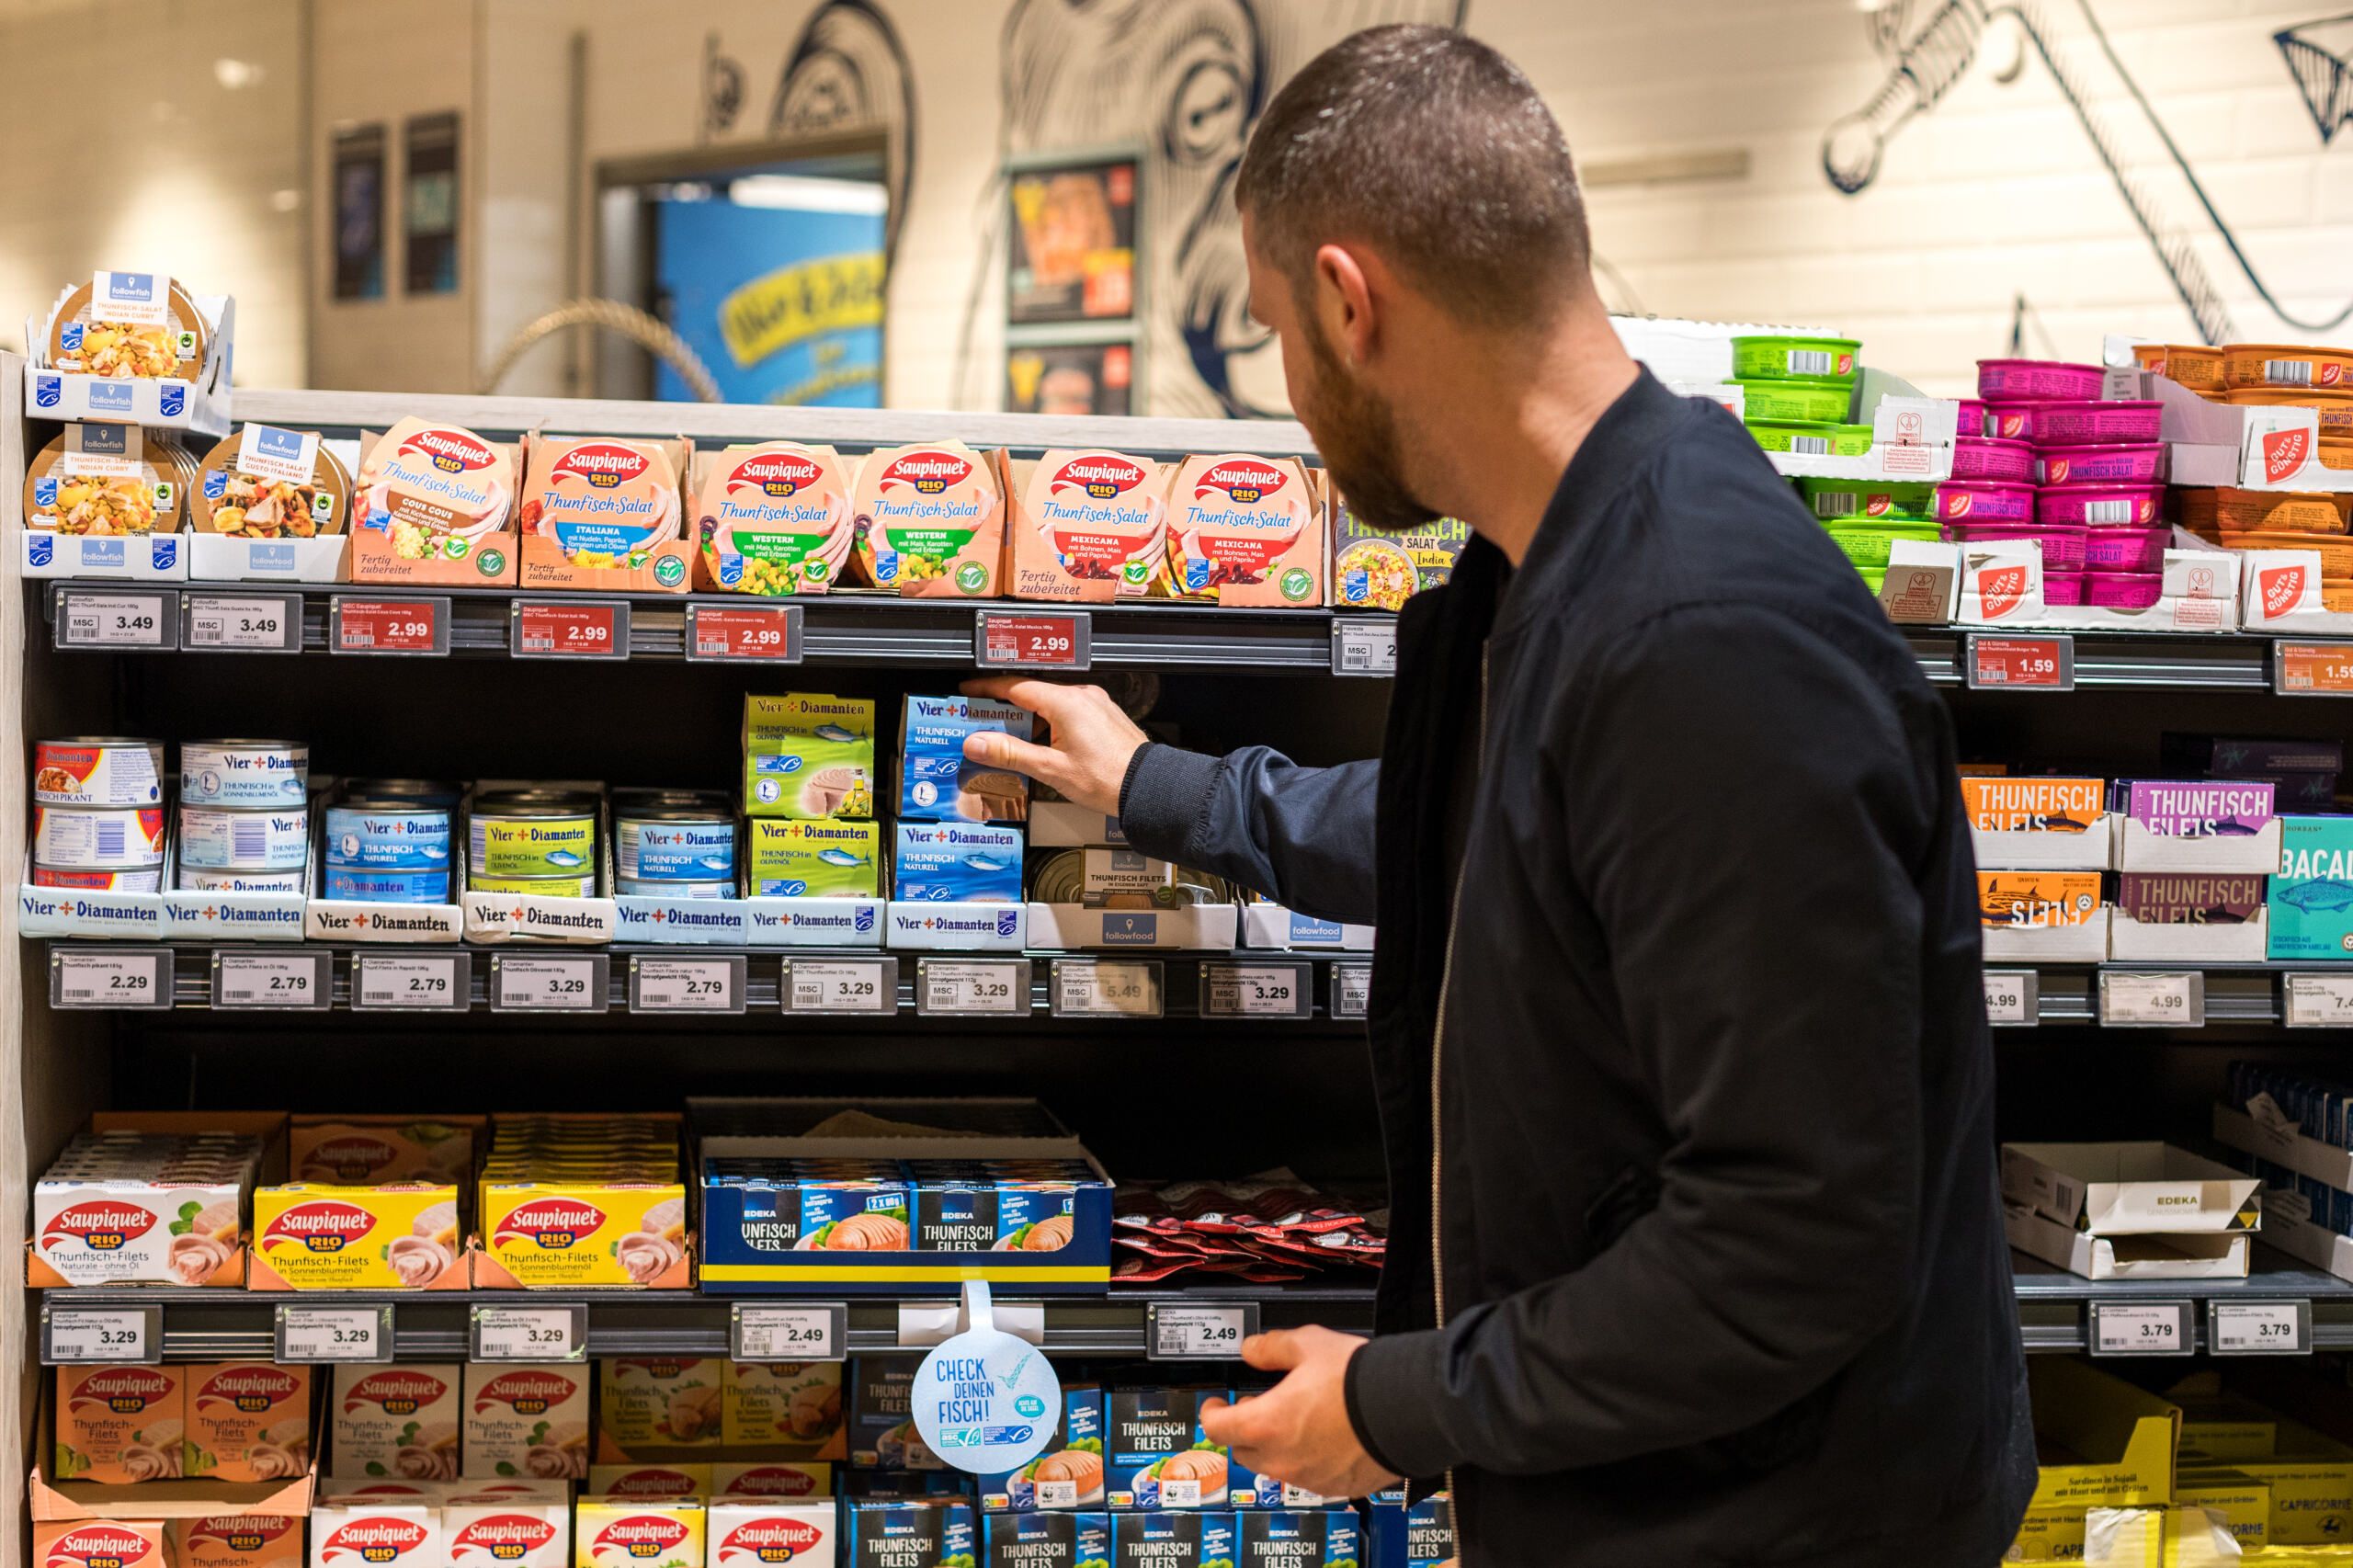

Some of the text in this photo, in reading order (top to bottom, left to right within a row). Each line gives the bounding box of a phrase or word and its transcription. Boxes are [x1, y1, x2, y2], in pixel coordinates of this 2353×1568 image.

[111, 286, 152, 298] followfish
[84, 438, 124, 449] followfish
[417, 431, 491, 465] Saupiquet
[2270, 433, 2302, 475] GÜNSTIG
[244, 454, 308, 473] THUNFISCH SALAT
[567, 452, 642, 472] Saupiquet
[894, 458, 965, 478] Saupiquet
[742, 460, 815, 482] Saupiquet
[1066, 461, 1139, 485] Saupiquet
[2070, 465, 2133, 477] THUNFISCH SALAT
[1209, 467, 1280, 489] Saupiquet
[765, 483, 793, 493] RIO
[1231, 489, 1260, 500] RIO
[402, 497, 454, 519] COUS COUS
[720, 501, 827, 523] Thunfisch-Salat
[1042, 501, 1149, 525] Thunfisch-Salat
[575, 526, 620, 536] ITALIANA
[752, 535, 795, 544] WESTERN
[1071, 535, 1120, 546] MEXICANA
[1407, 538, 1435, 550] SALAT
[744, 543, 755, 551] mit
[756, 544, 771, 553] Mais,
[82, 552, 124, 564] followfish
[251, 555, 293, 566] followfood
[1417, 552, 1445, 565] India
[360, 565, 412, 576] zubereitet
[1019, 569, 1058, 584] Fertig
[1019, 581, 1081, 596] zubereitet
[2267, 571, 2299, 611] GÜNSTIG
[74, 619, 94, 627] MSC
[116, 616, 153, 630] 3.49
[198, 621, 218, 630] MSC
[240, 619, 277, 632] 3.49
[388, 622, 427, 637] 2.99
[742, 631, 780, 644] 2.99
[1031, 635, 1069, 651] 2.99
[2019, 659, 2054, 673] 1.59
[757, 699, 865, 715] Vier Diamanten
[916, 701, 1024, 722] Vier Diamanten
[915, 726, 965, 737] THUNFISCH
[915, 737, 949, 745] NATURELL
[46, 752, 93, 763] Diamanten
[223, 782, 266, 790] THUNFISCH
[59, 794, 93, 803] PIKANT
[1979, 784, 2098, 812] THUNFISCH
[2150, 790, 2268, 817] THUNFISCH
[761, 824, 869, 841] Vier Diamanten
[906, 828, 1014, 846] Vier Diamanten
[364, 845, 413, 854] THUNFISCH
[364, 855, 397, 863] NATURELL
[760, 858, 790, 866] OLIVENÖL
[904, 853, 955, 863] THUNFISCH
[904, 863, 938, 871] NATURELL
[1090, 874, 1137, 882] THUNFISCH
[2140, 879, 2257, 905] THUNFISCH
[23, 897, 157, 921] Vier Diamanten
[166, 905, 301, 923] Vier Diamanten
[619, 905, 742, 926] Vier Diamanten
[475, 905, 604, 929] Vier Diamanten
[897, 915, 995, 932] Vier Diamanten
[1105, 930, 1154, 941] followfood
[1292, 927, 1340, 936] followfood
[110, 976, 148, 989] 2.29
[270, 977, 307, 990] 2.79
[549, 980, 585, 993] 3.29
[687, 981, 722, 994] 2.79
[973, 984, 1008, 996] 3.29
[1067, 988, 1087, 996] MSC
[1107, 985, 1142, 998] 5.49
[1256, 987, 1289, 999] 3.29
[1985, 994, 2018, 1007] 4.99
[2150, 995, 2183, 1008] 4.99
[2157, 1197, 2198, 1206] EDEKA
[60, 1209, 148, 1231] Saupiquet
[511, 1208, 597, 1230] Saupiquet
[744, 1210, 777, 1218] EDEKA
[279, 1210, 368, 1233] Saupiquet
[87, 1234, 122, 1244] RIO
[539, 1233, 572, 1244] RIO
[923, 1224, 994, 1241] THUNFISCH
[51, 1251, 150, 1262] Thunfisch-Filets
[503, 1253, 598, 1263] Thunfisch-Filets
[61, 1262, 97, 1270] Naturale
[128, 1262, 140, 1270] Öl
[528, 1329, 563, 1342] 3.29
[788, 1328, 824, 1342] 2.49
[2141, 1324, 2172, 1336] 3.79
[2259, 1324, 2290, 1335] 3.79
[100, 1331, 137, 1344] 3.29
[937, 1358, 986, 1381] CHECK
[212, 1377, 292, 1393] Saupiquet
[954, 1381, 995, 1398] DEINEN
[938, 1402, 990, 1424] FISCH!
[73, 1419, 134, 1429] Thunfisch-
[1121, 1421, 1187, 1437] THUNFISCH
[89, 1429, 119, 1439] Filets
[1134, 1437, 1172, 1450] FILETS
[2068, 1476, 2102, 1486] Sardinen
[2055, 1488, 2068, 1496] mit
[2069, 1487, 2090, 1496] Haut
[2091, 1486, 2107, 1494] und
[2108, 1485, 2120, 1494] mit
[2280, 1499, 2351, 1511] CAPRICORNE
[338, 1525, 419, 1544] Saupiquet
[608, 1523, 682, 1540] Saupiquet
[63, 1536, 143, 1555] Saupiquet
[868, 1539, 932, 1553] THUNFISCH
[1252, 1541, 1316, 1557] THUNFISCH
[881, 1552, 919, 1567] FILETS
